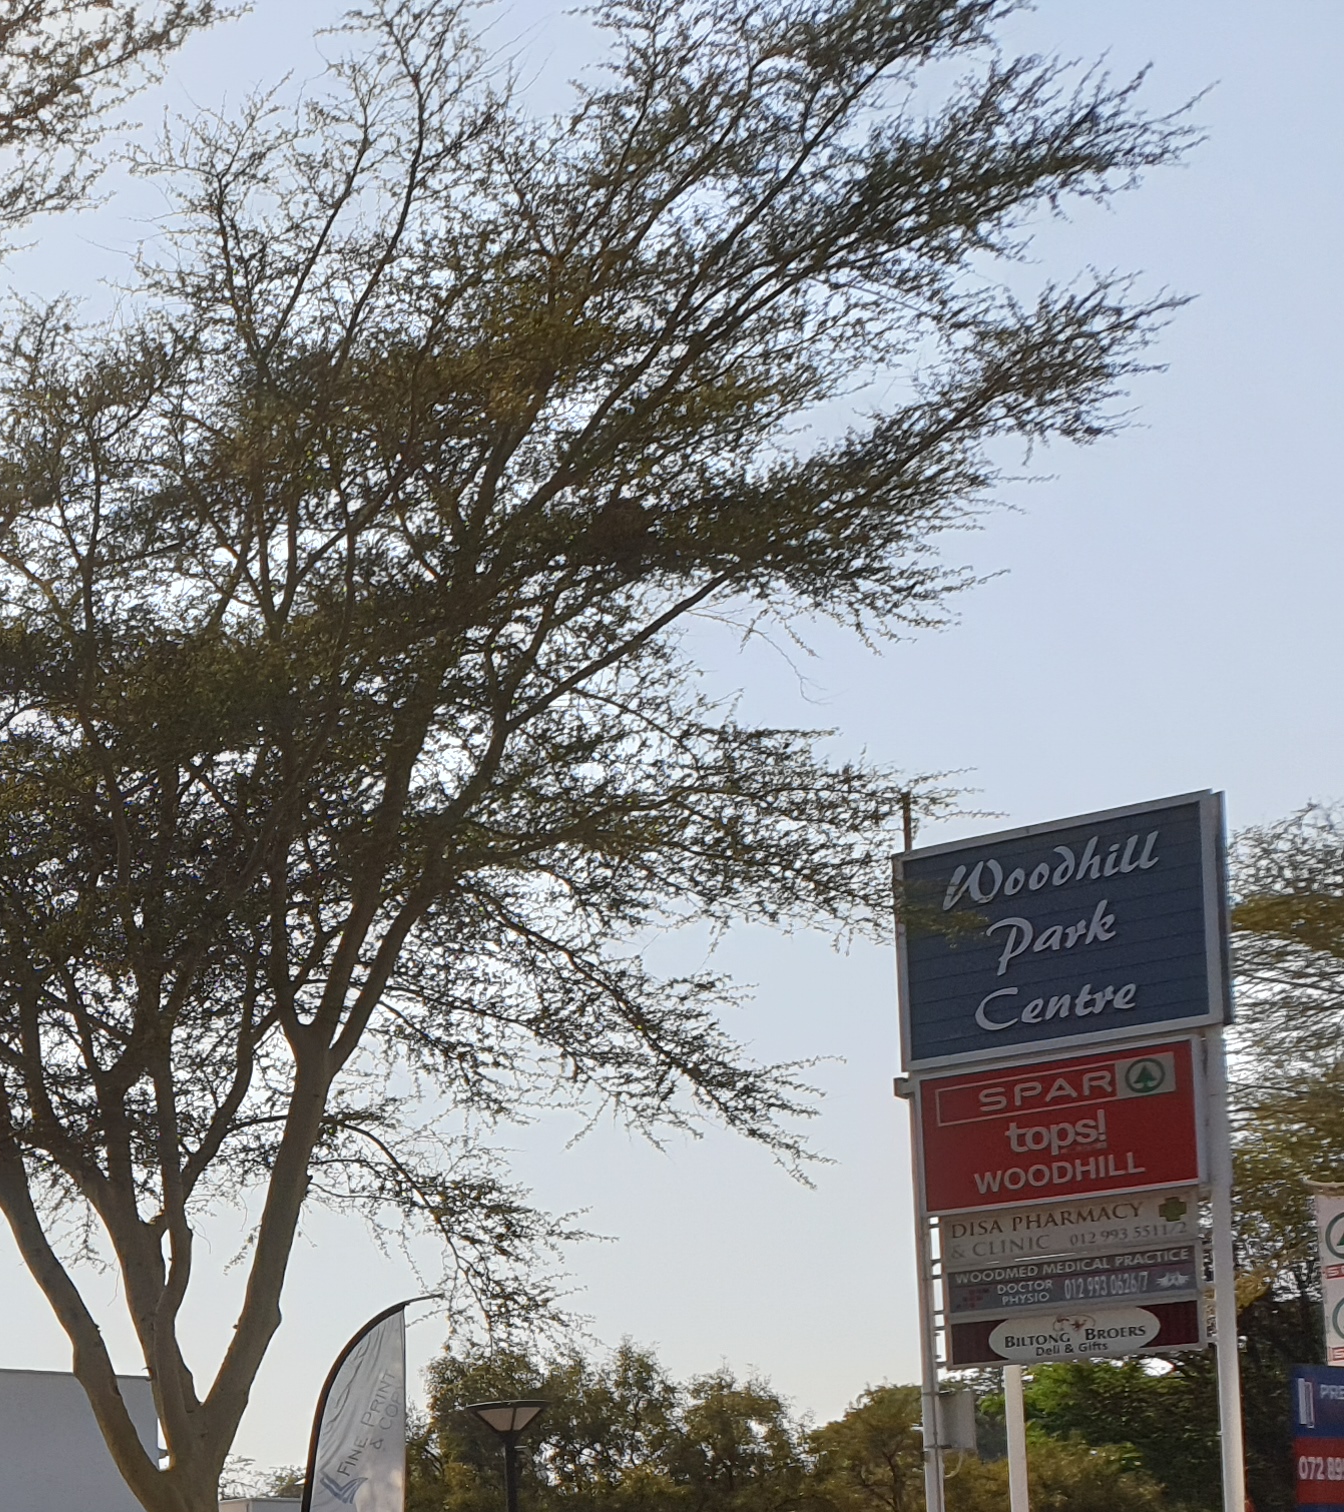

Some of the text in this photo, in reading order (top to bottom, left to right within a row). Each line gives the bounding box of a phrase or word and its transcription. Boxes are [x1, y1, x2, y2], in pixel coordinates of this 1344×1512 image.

[943, 830, 1160, 911] Woodhill
[986, 899, 1117, 976] Park
[975, 983, 1137, 1031] Centre
[978, 1070, 1113, 1112] SPAR
[1004, 1108, 1107, 1156] tops!
[974, 1152, 1146, 1194] WOODHILL
[952, 1201, 1144, 1239] DISA PHARMACY
[951, 1244, 966, 1259] &
[972, 1234, 1051, 1257] CLINIC
[1070, 1231, 1096, 1246] 012
[1101, 1225, 1128, 1243] 993
[955, 1249, 1189, 1284] WOODMED MEDICAL PRACTICE
[997, 1279, 1053, 1295] DOCTOR
[1002, 1292, 1050, 1306] PHYSIO
[1064, 1278, 1085, 1299] 012
[1087, 1276, 1107, 1297] 993
[1004, 1325, 1146, 1349] BILTONG BROERS
[1035, 1342, 1108, 1357] Deli & Gifts
[336, 1368, 396, 1477] FINE PRINT
[1298, 1455, 1344, 1481] 072 89
